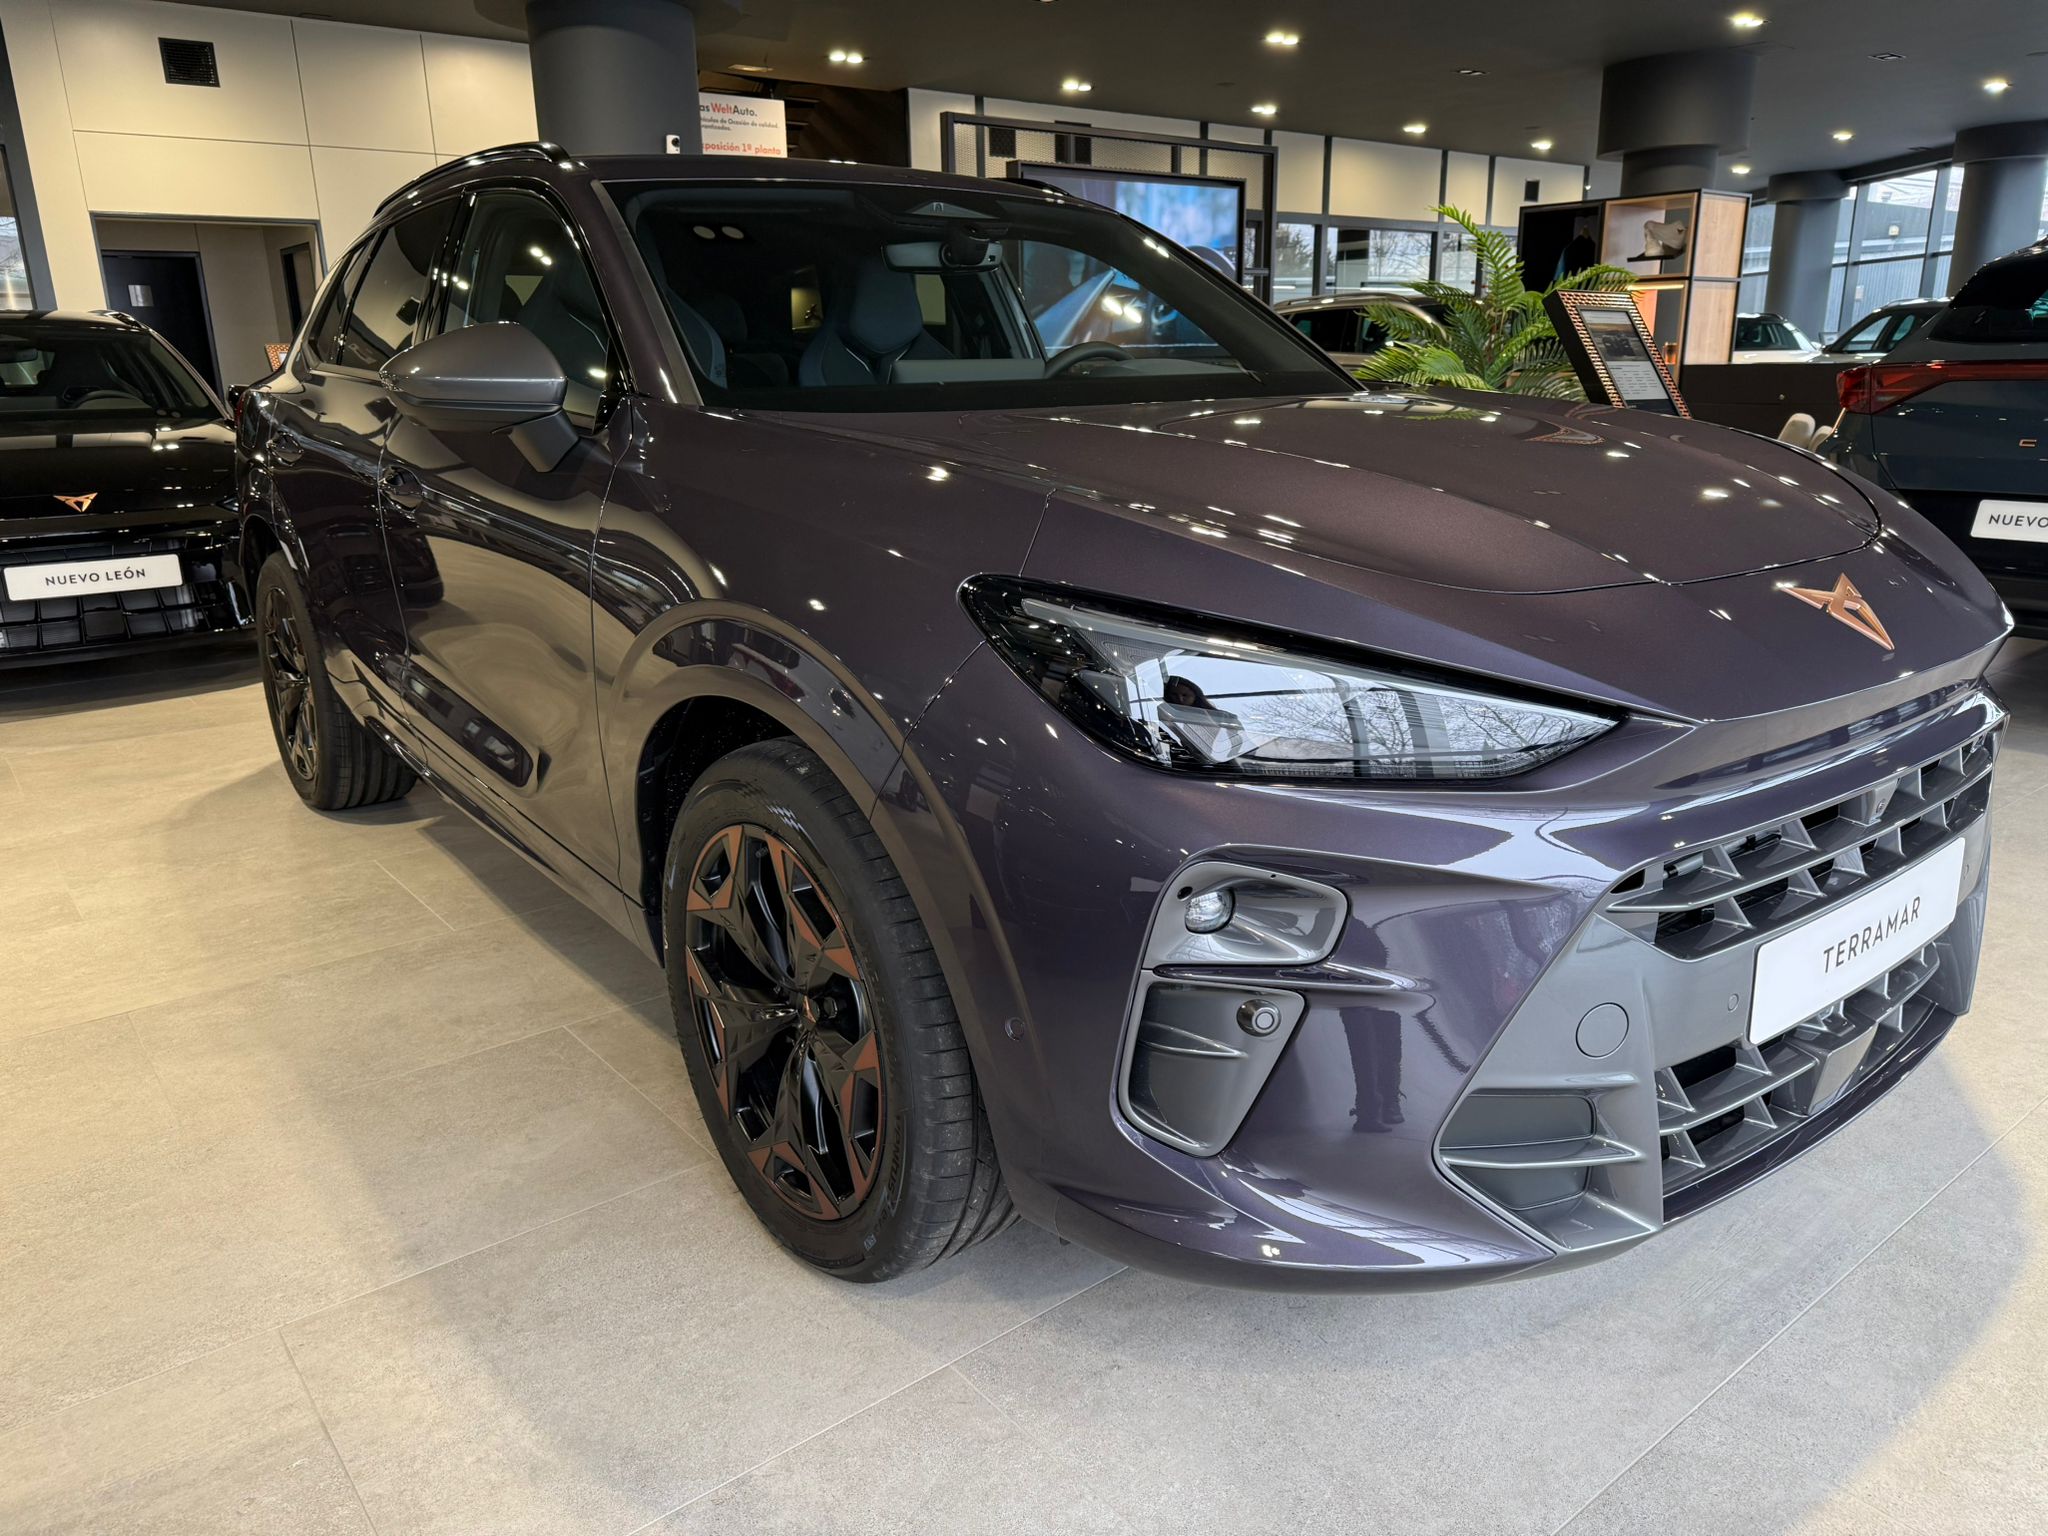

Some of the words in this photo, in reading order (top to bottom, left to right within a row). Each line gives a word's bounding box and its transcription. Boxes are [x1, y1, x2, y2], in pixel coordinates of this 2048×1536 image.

[711, 103, 758, 117] WeltAuto.
[755, 144, 781, 155] planta
[1988, 514, 2048, 528] NUEVO
[45, 572, 100, 586] NUEVO
[106, 567, 146, 581] LEÓN
[1823, 896, 1921, 974] TERRAMAR
